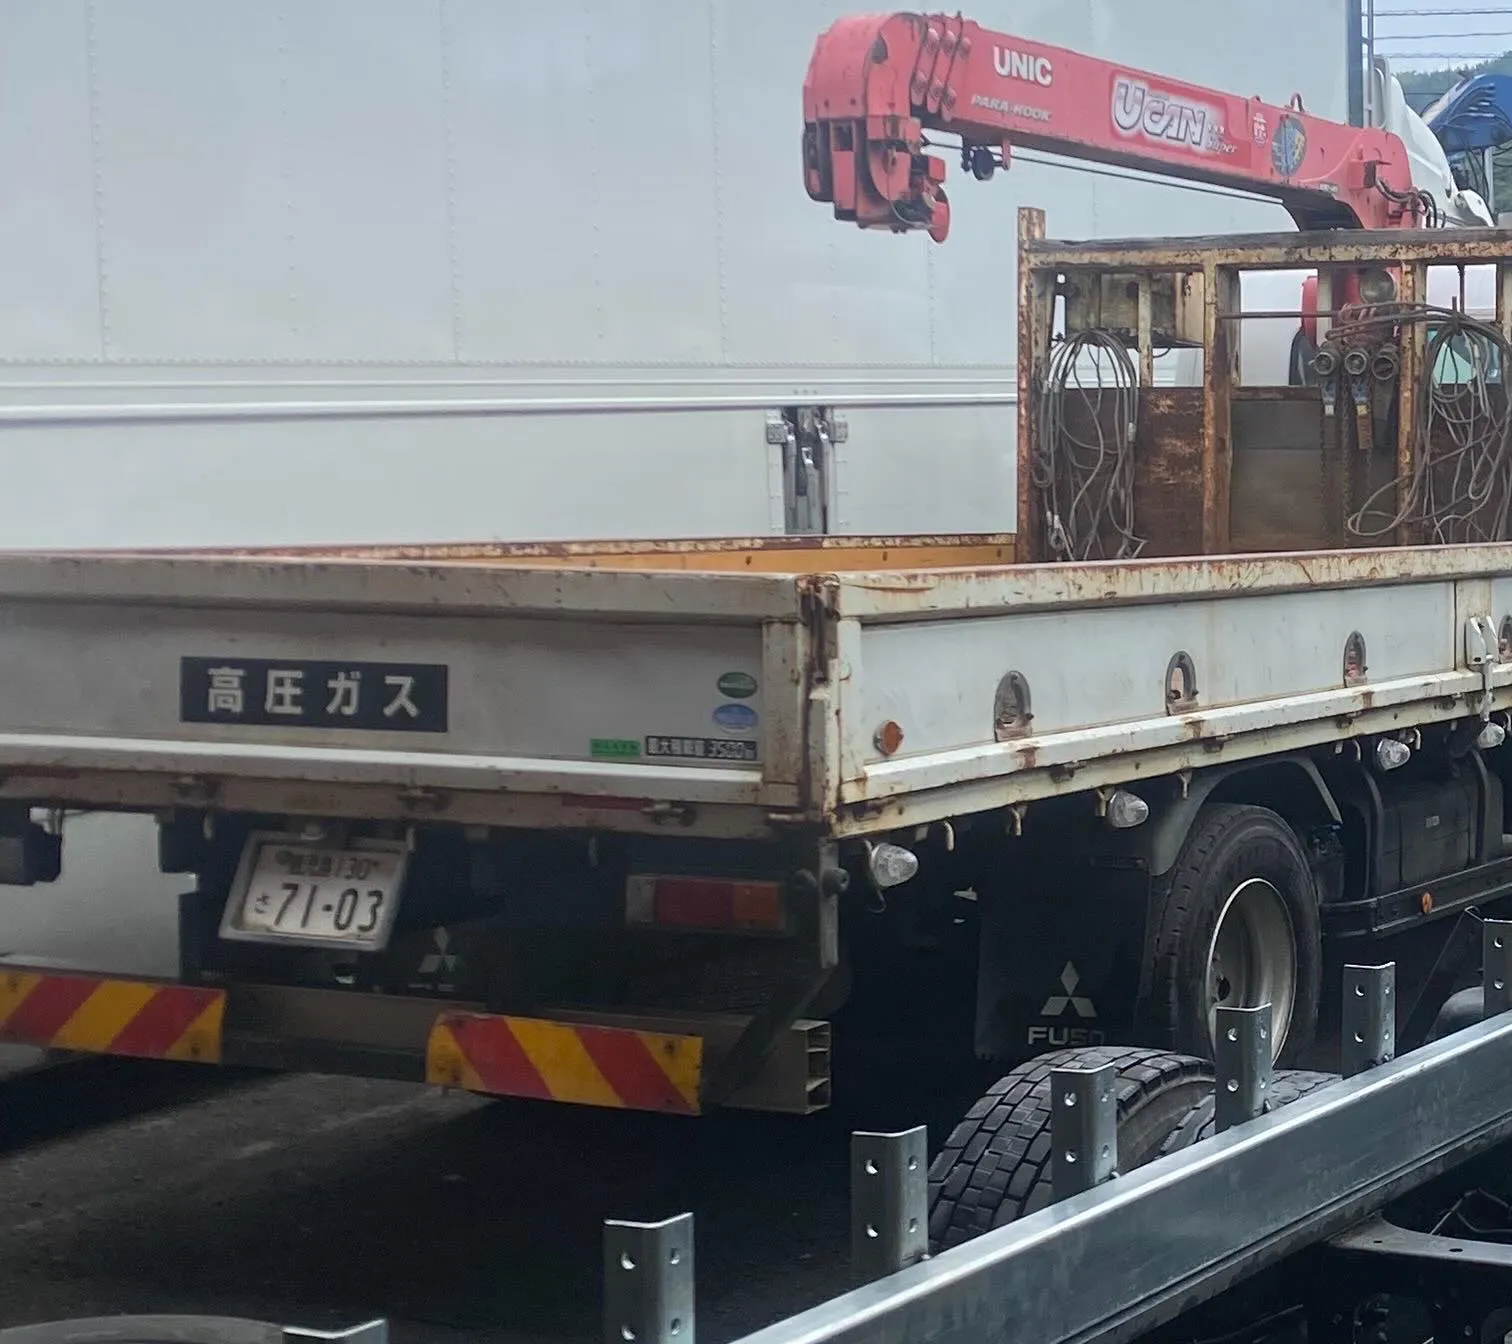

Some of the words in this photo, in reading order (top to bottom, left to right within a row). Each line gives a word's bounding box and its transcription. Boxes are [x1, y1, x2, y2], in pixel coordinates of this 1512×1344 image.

[993, 45, 1053, 87] UNIC
[206, 666, 420, 718] 高圧ガス
[273, 882, 383, 933] 71-03
